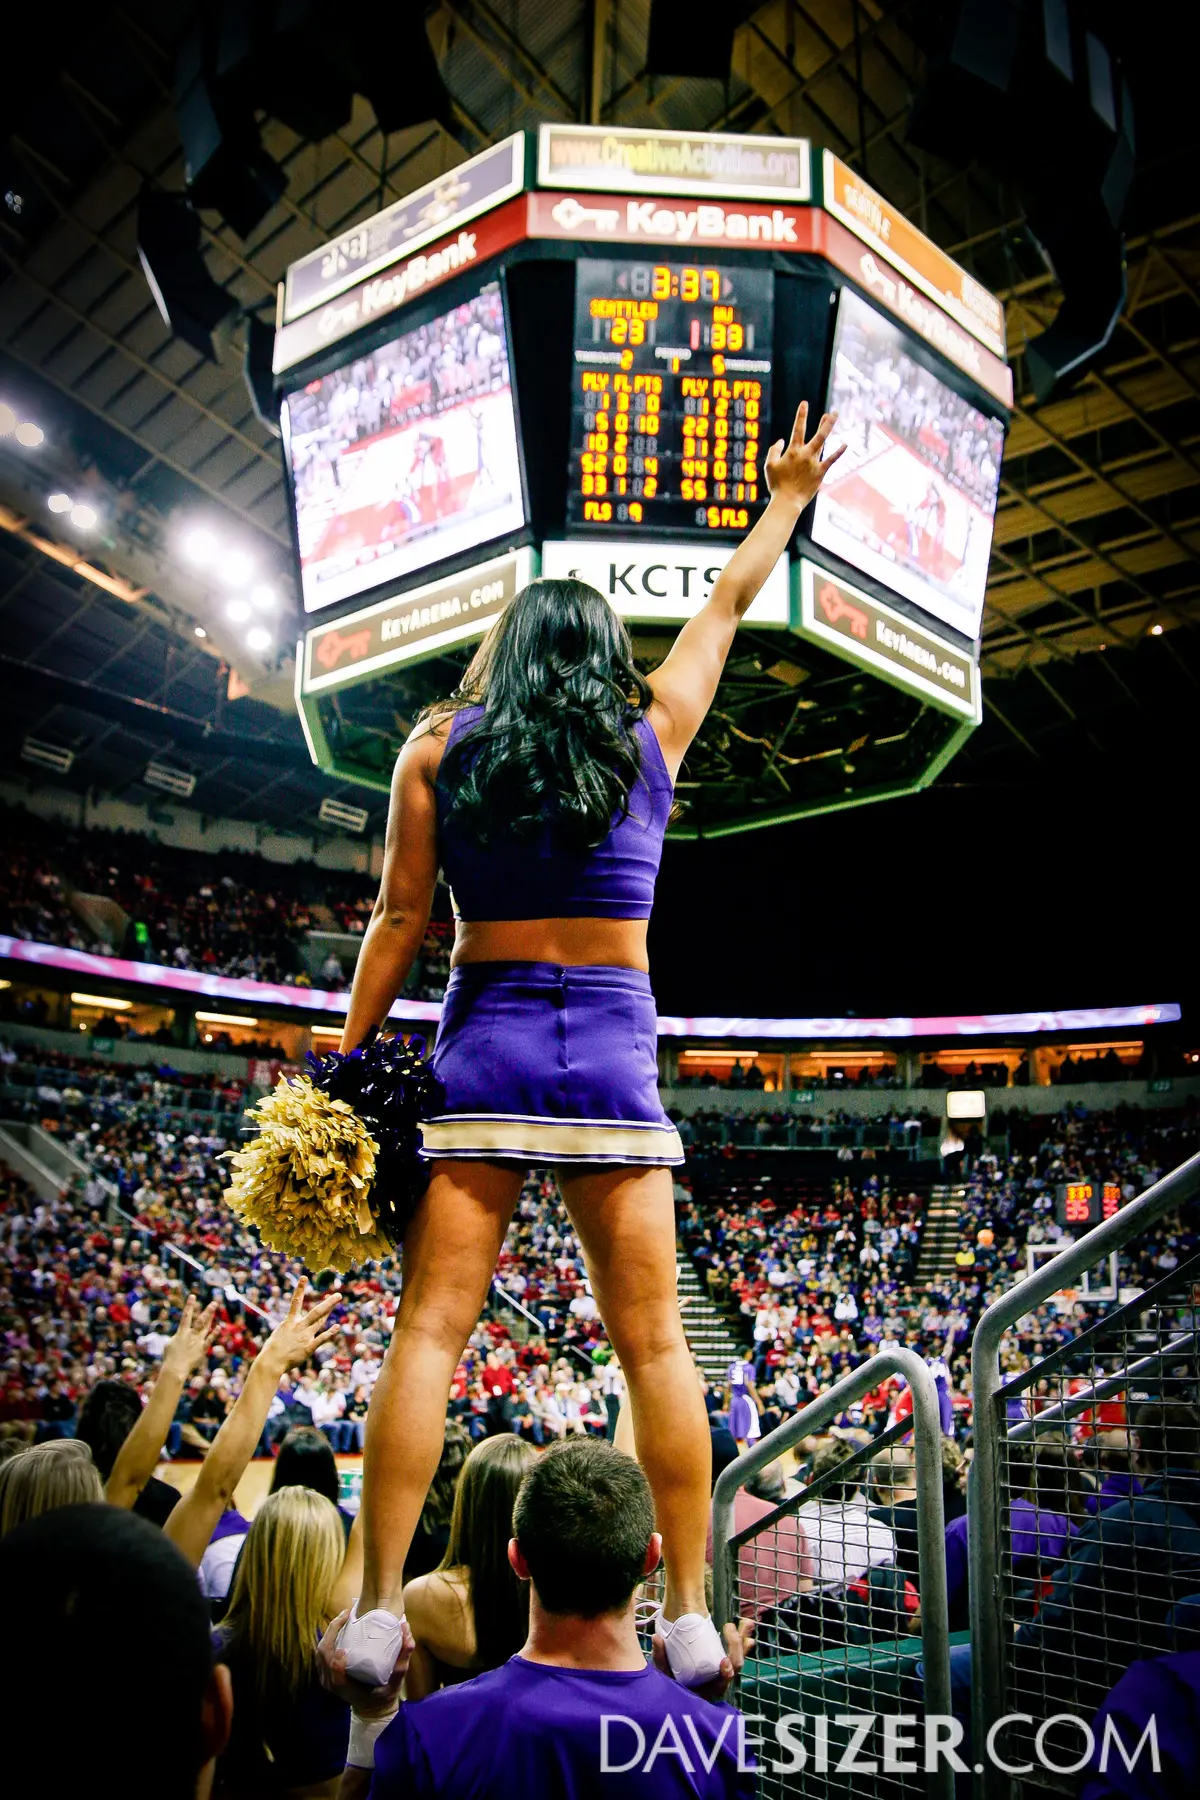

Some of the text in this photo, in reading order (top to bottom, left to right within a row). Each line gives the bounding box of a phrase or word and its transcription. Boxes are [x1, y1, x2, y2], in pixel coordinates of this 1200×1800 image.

[627, 201, 798, 242] KeyBank
[362, 232, 476, 315] KeyBank
[652, 265, 721, 302] 3:37
[611, 316, 645, 346] 23
[711, 323, 744, 351] 33
[582, 373, 662, 394] PLY FL PTS
[682, 378, 761, 399] PLY FL PTS
[617, 392, 629, 412] 3
[646, 394, 659, 413] 0
[715, 398, 728, 417] 2
[745, 400, 759, 419] 0
[596, 412, 659, 434] 5 0 10
[683, 416, 758, 439] 22 0 4
[588, 433, 627, 454] 10 2
[683, 437, 758, 461] 31 2 2
[581, 453, 657, 475] 52 0 4
[681, 460, 757, 482] 44 0 6
[582, 474, 606, 495] 33
[644, 477, 657, 497] 2
[681, 479, 707, 500] 55
[737, 483, 757, 501] 11
[584, 502, 642, 522] FLS 9
[707, 507, 748, 527] 5 FLS
